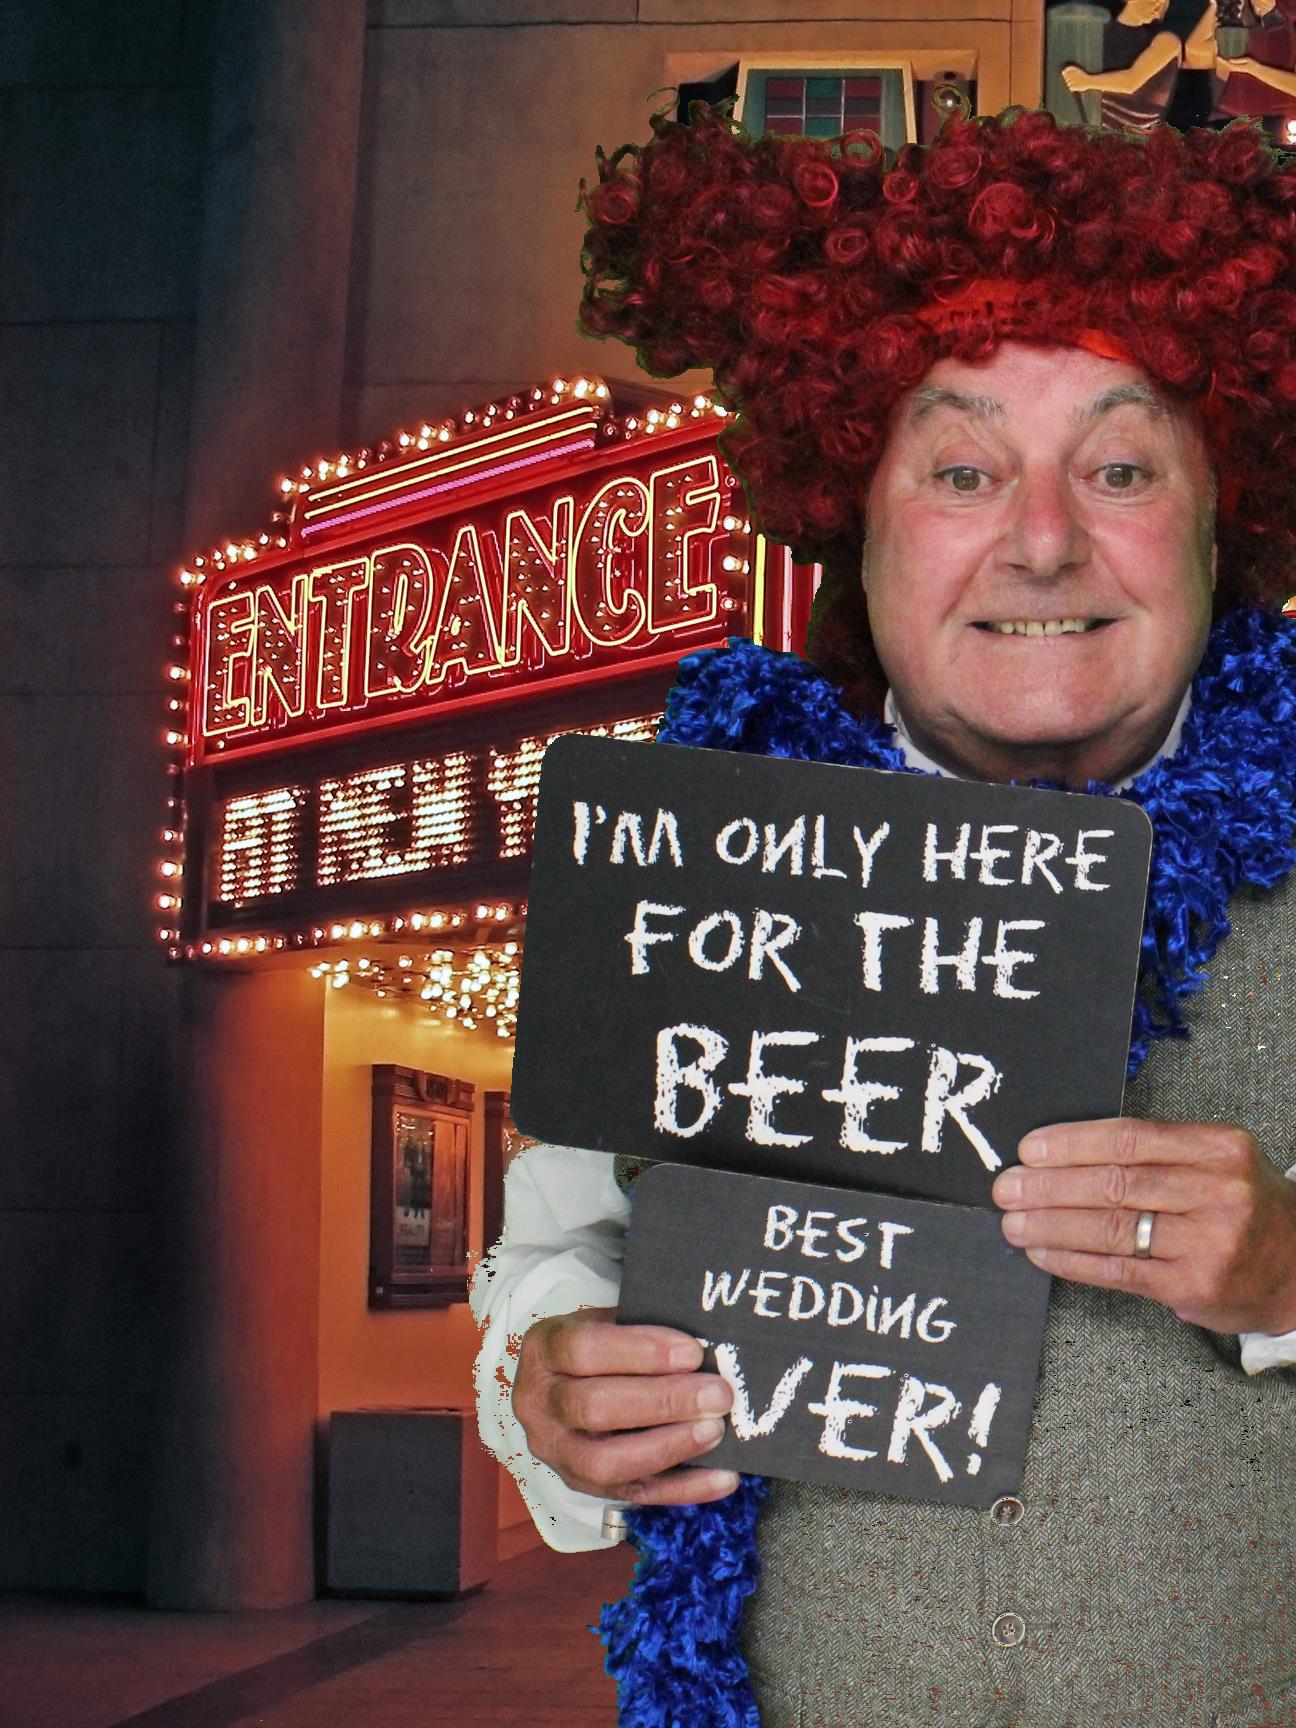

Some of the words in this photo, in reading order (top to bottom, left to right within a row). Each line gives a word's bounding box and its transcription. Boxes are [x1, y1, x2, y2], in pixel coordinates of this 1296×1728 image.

[202, 455, 720, 738] ENTRANCE
[572, 801, 684, 868] I'M
[716, 814, 890, 888] ONLY
[922, 823, 1116, 894] HERE
[624, 899, 802, 992] FOR
[854, 911, 1050, 1000] THE
[652, 1022, 1003, 1171] BEER
[763, 1204, 914, 1270] BEST
[697, 1337, 1002, 1484] VER!
